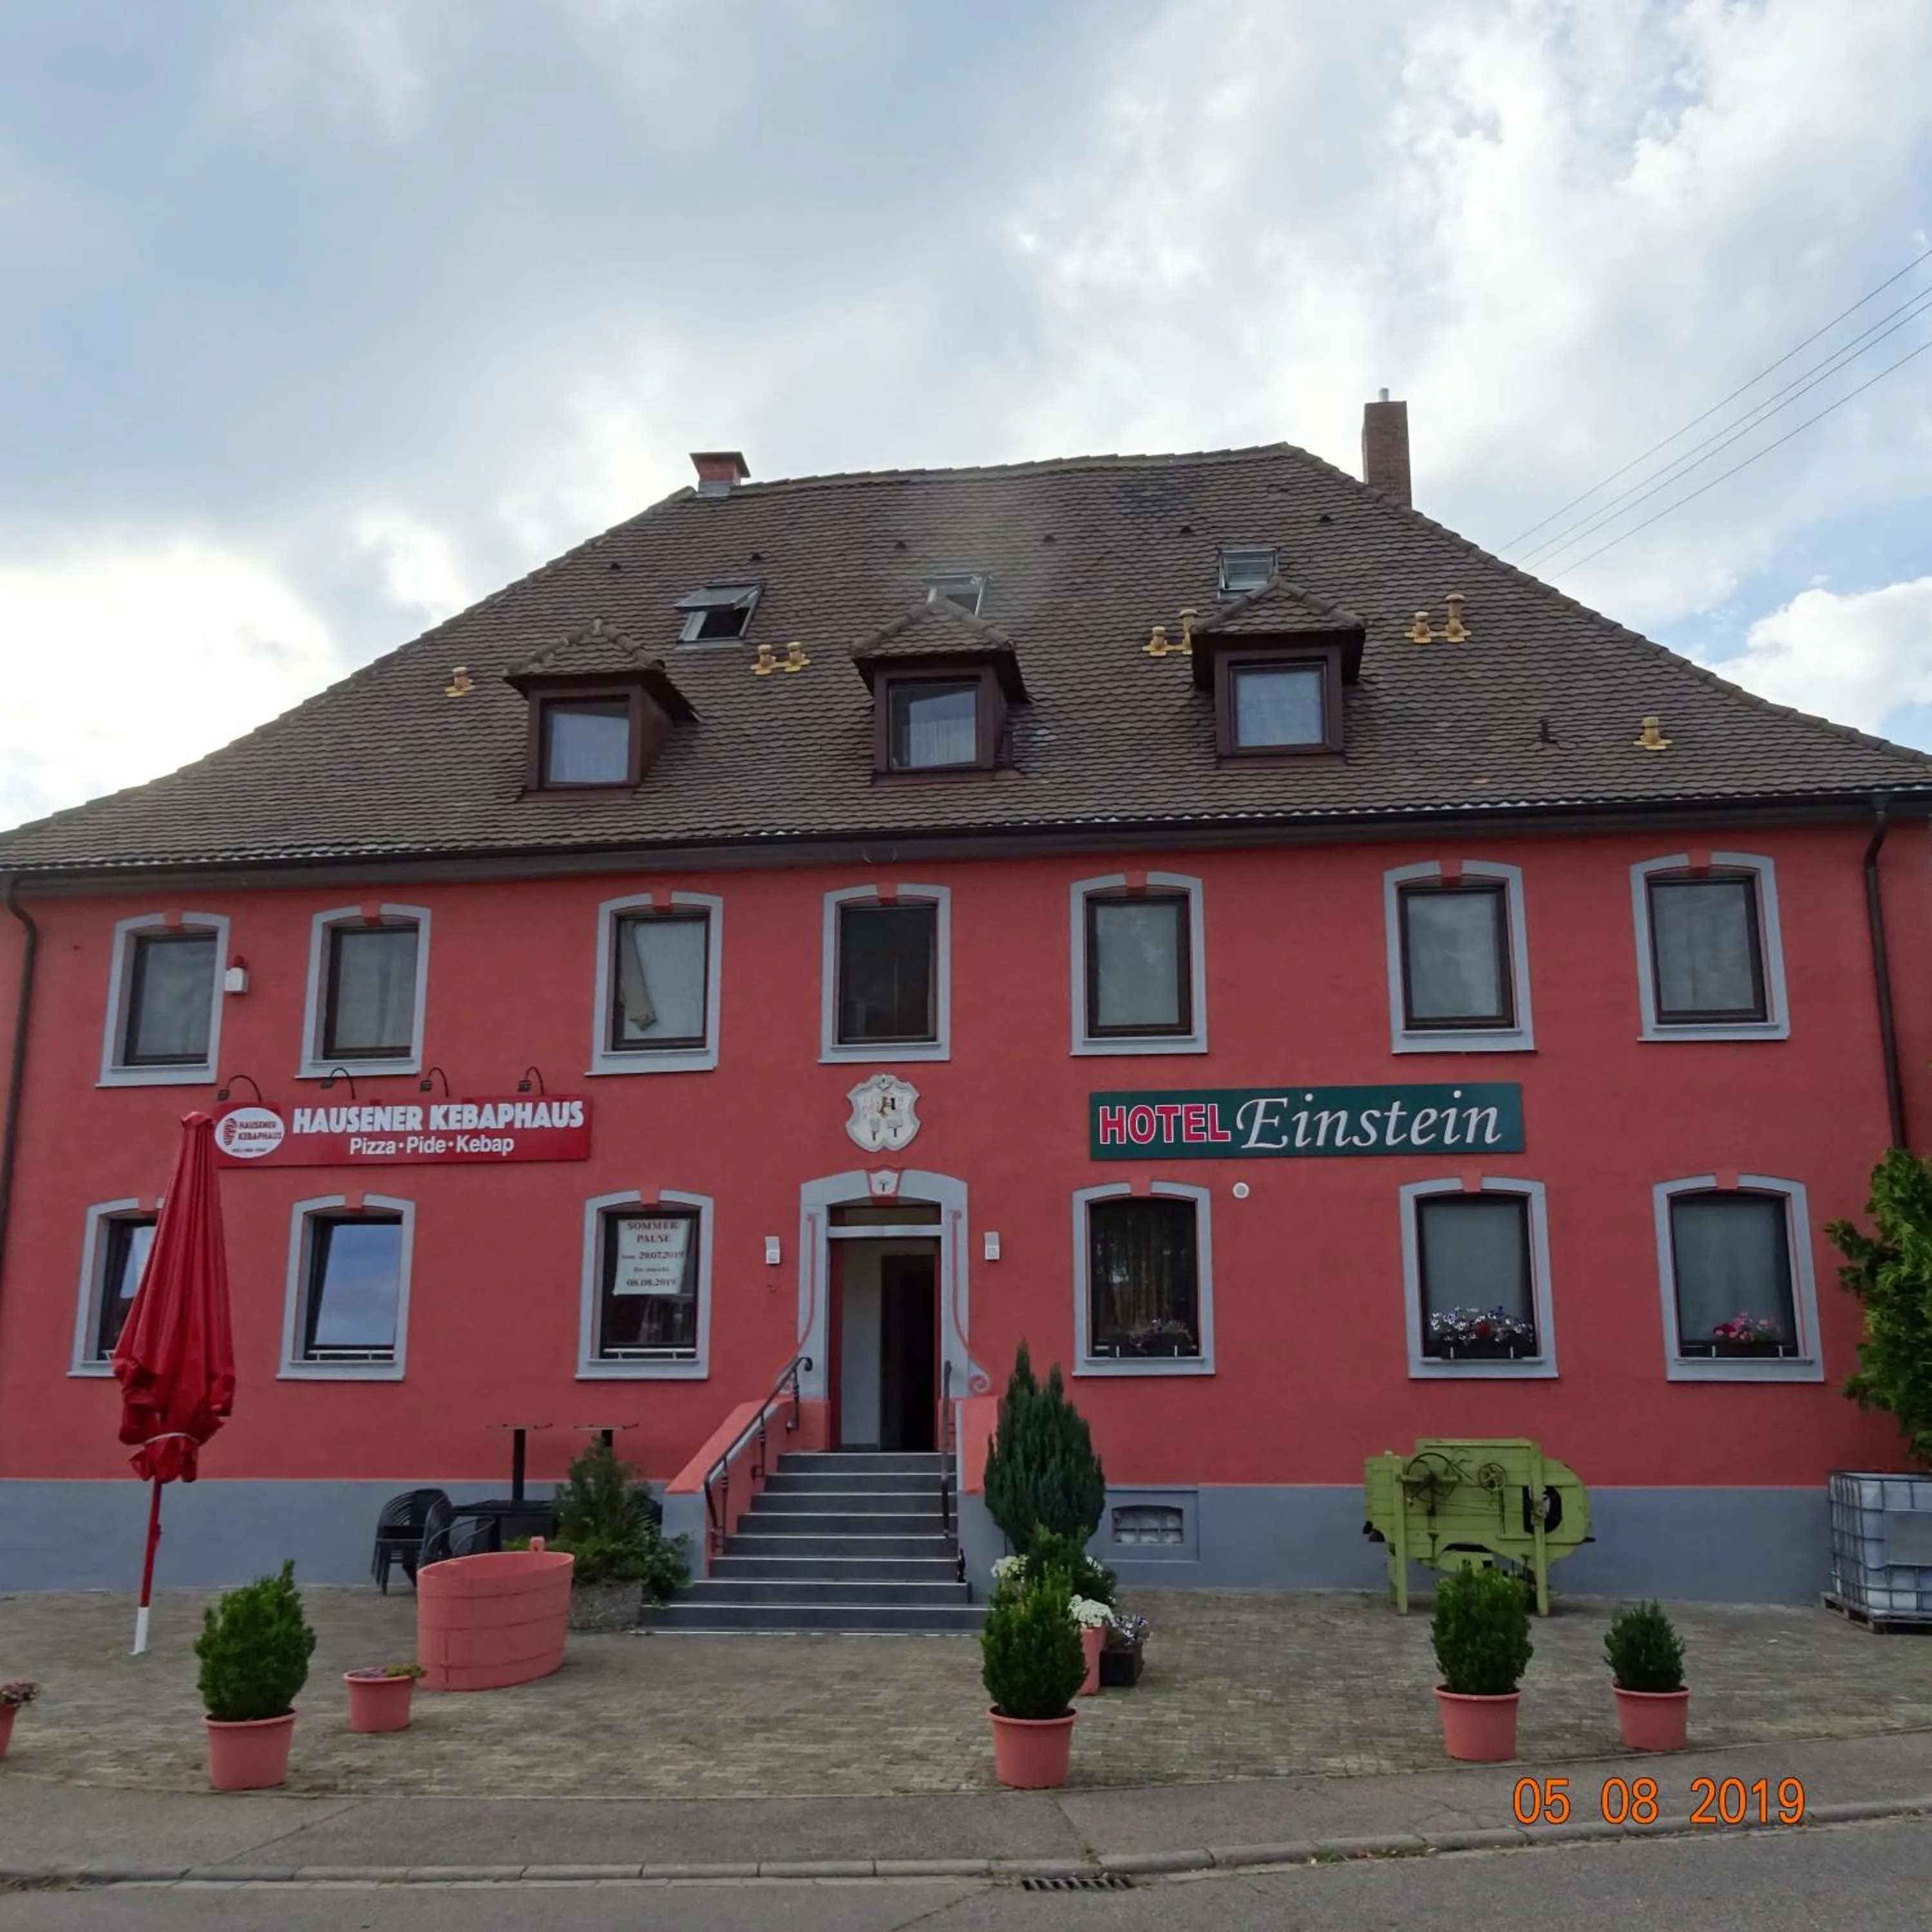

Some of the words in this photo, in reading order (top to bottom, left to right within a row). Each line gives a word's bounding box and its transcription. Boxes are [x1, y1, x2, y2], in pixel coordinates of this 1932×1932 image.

[239, 1121, 277, 1130] HAUSENER
[293, 1106, 422, 1134] HAUSENER
[429, 1101, 583, 1132] KEBAPHAUS
[1099, 1103, 1231, 1144] HOTEL
[1236, 1090, 1502, 1150] Einstein
[238, 1132, 281, 1141] KEBAPHAUS
[350, 1136, 396, 1155] Pizza
[406, 1135, 446, 1154] Pide
[455, 1134, 514, 1155] Kebap
